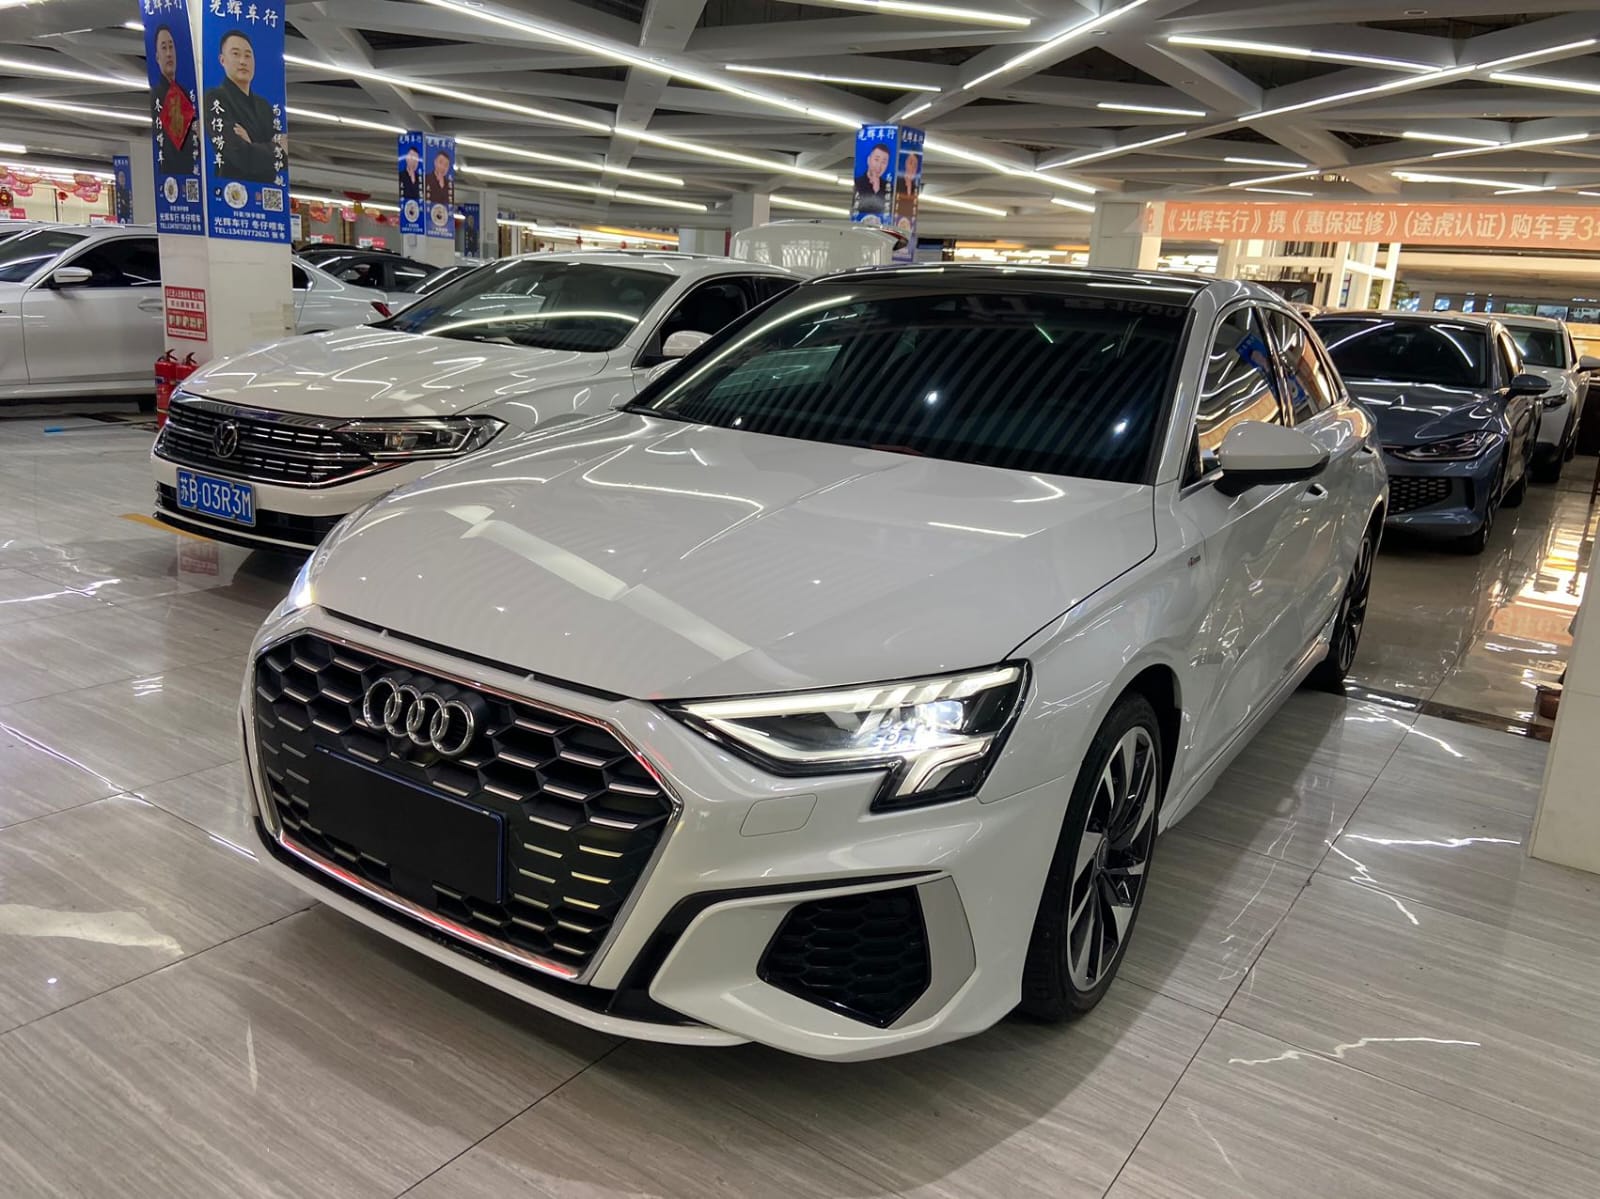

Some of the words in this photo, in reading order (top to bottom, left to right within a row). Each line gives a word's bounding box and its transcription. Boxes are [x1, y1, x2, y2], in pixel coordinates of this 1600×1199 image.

[209, 0, 279, 28] 光辉车行
[214, 216, 249, 229] 光辉车行
